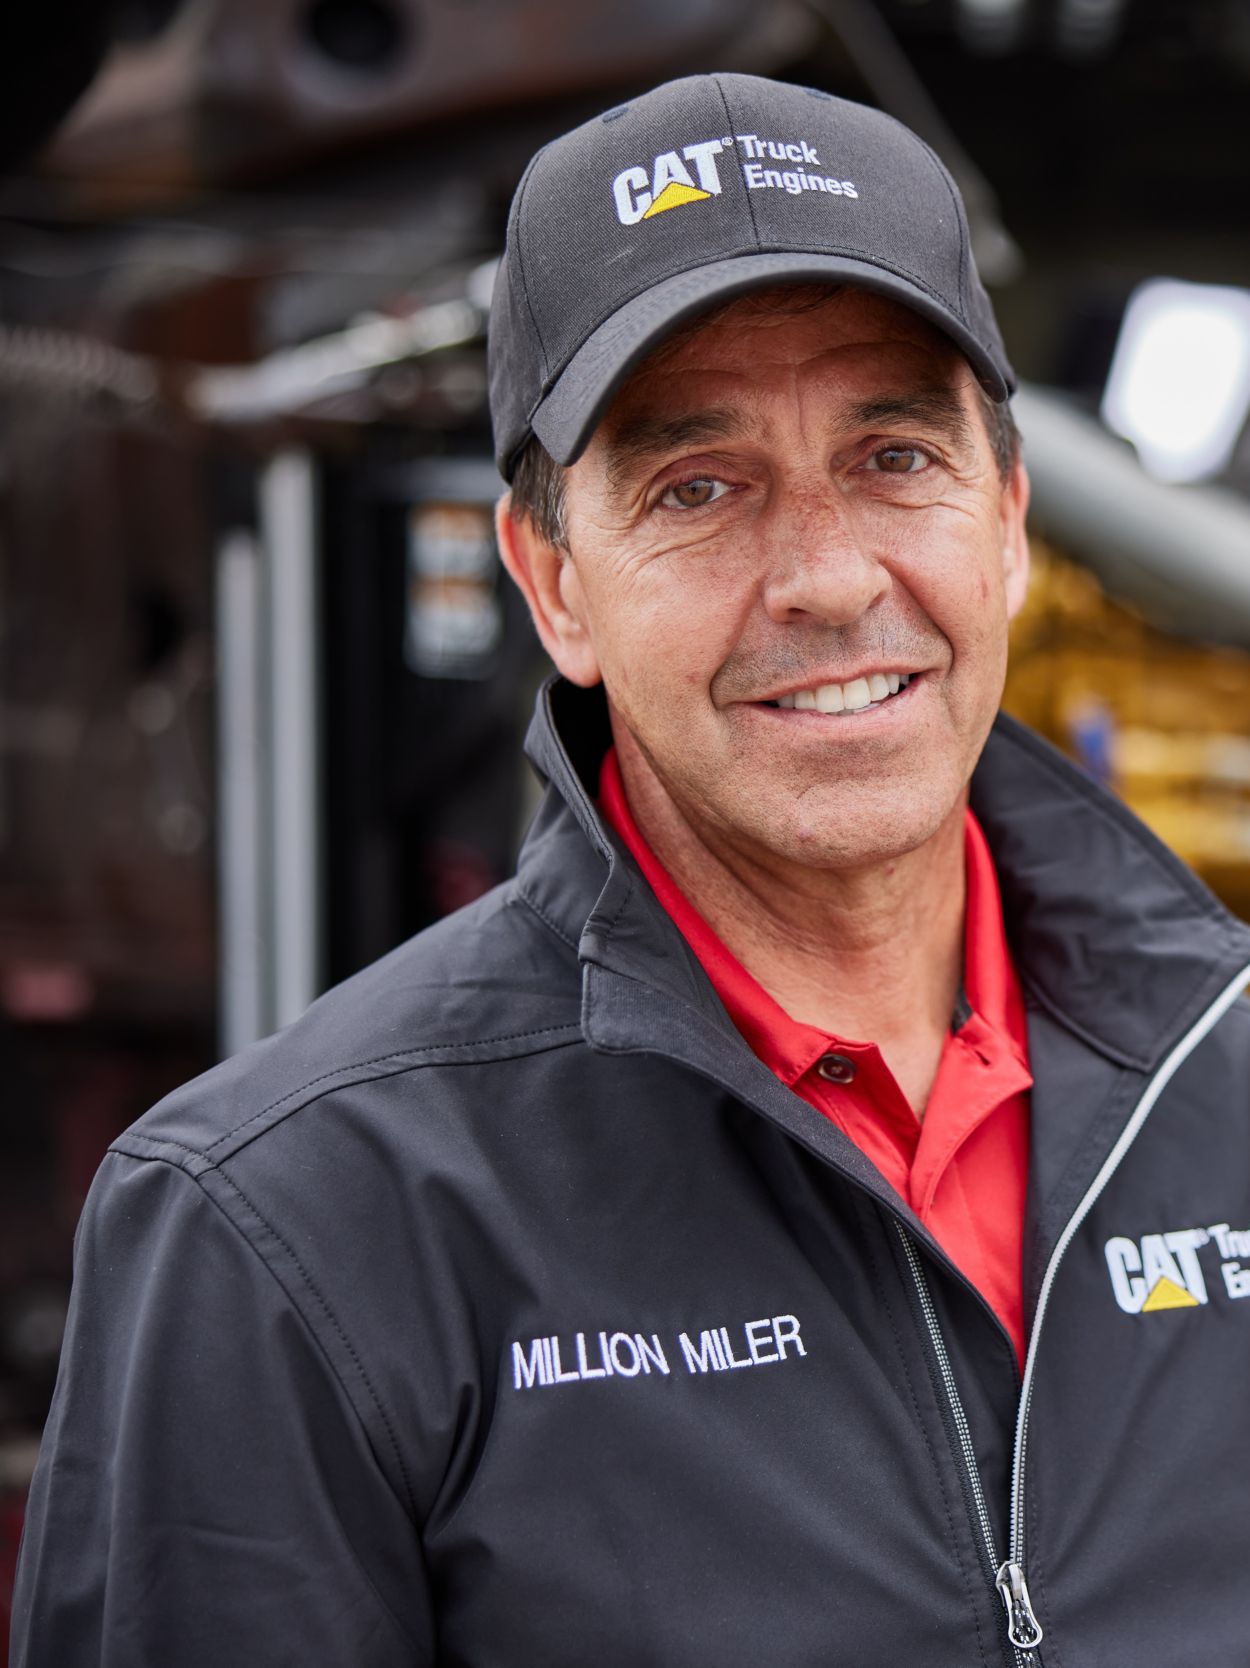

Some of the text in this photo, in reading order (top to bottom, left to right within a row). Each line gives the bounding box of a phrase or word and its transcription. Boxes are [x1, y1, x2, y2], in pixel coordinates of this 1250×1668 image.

[613, 139, 724, 226] CAT
[737, 135, 821, 166] Truck
[744, 164, 859, 199] Engines
[1104, 1228, 1209, 1315] CAT
[512, 1314, 808, 1390] MILLION MILER
